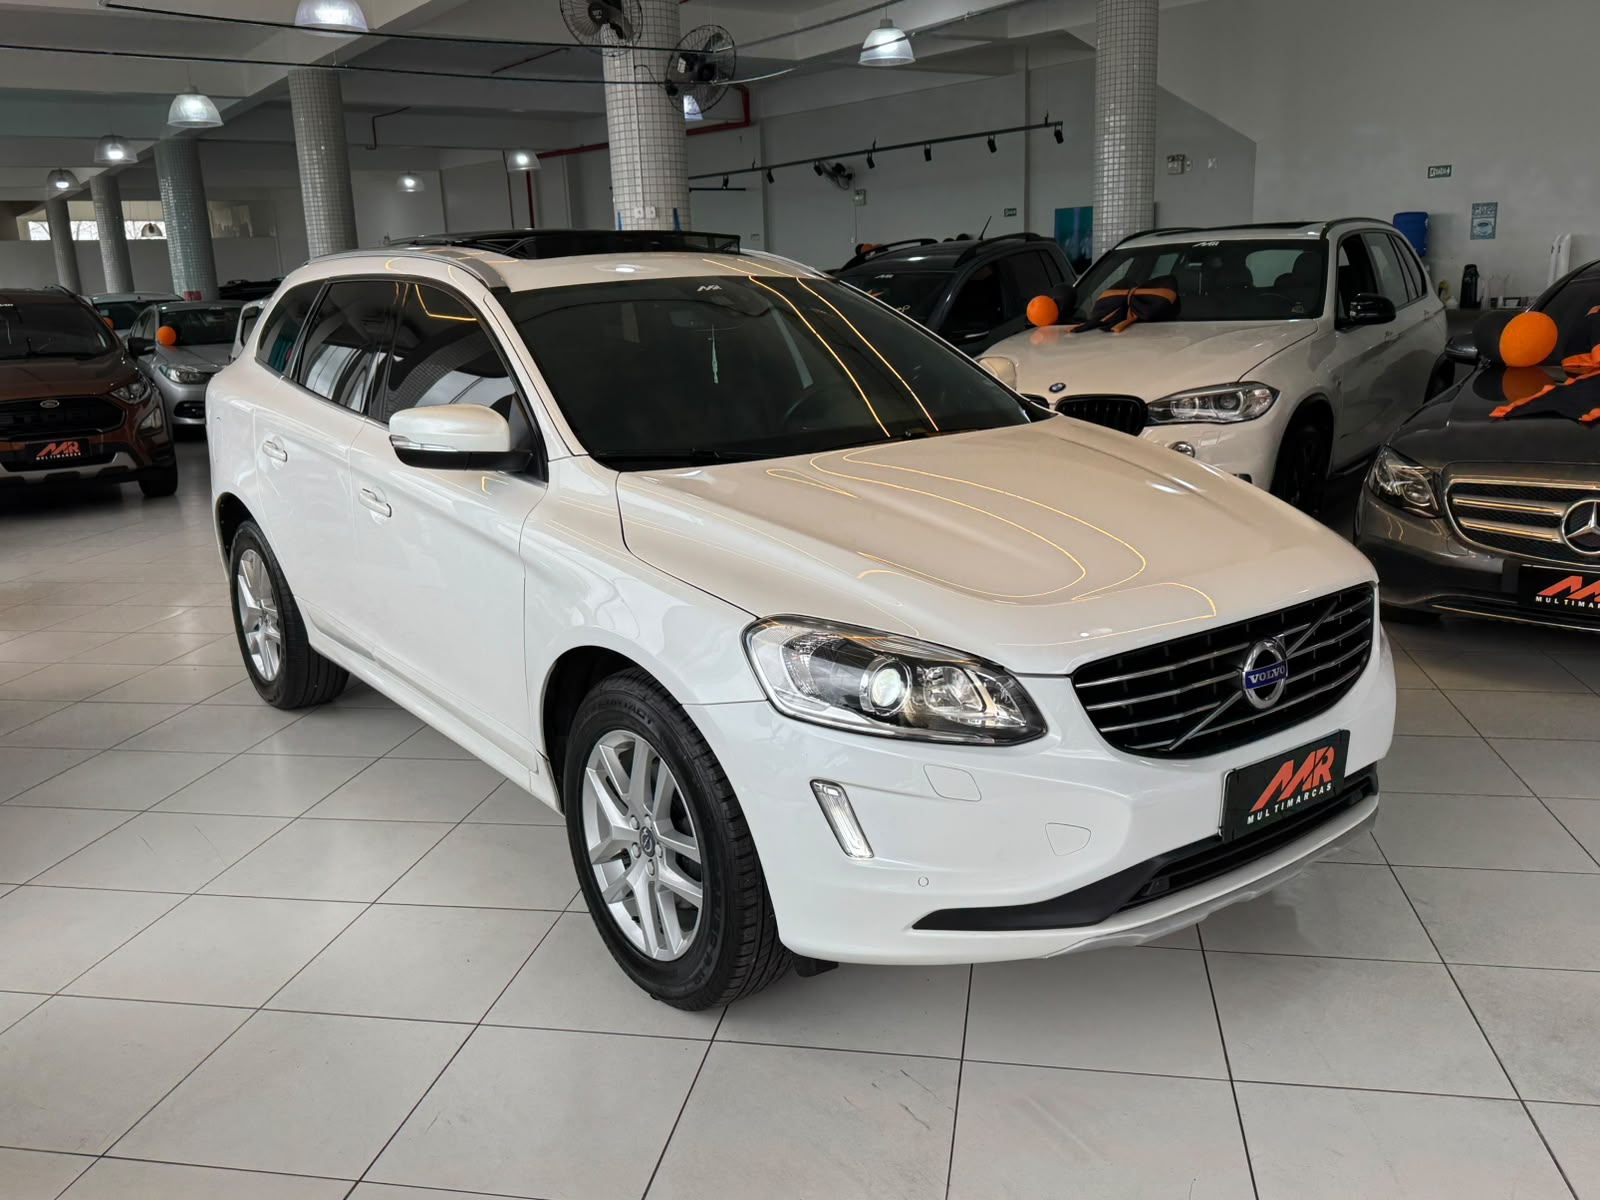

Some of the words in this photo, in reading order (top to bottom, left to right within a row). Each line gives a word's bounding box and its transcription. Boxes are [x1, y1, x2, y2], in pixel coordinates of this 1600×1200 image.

[36, 441, 81, 456] MR
[1248, 665, 1285, 683] VOLVO
[1249, 746, 1335, 813] MR
[1246, 782, 1332, 825] MULTIMARCAS
